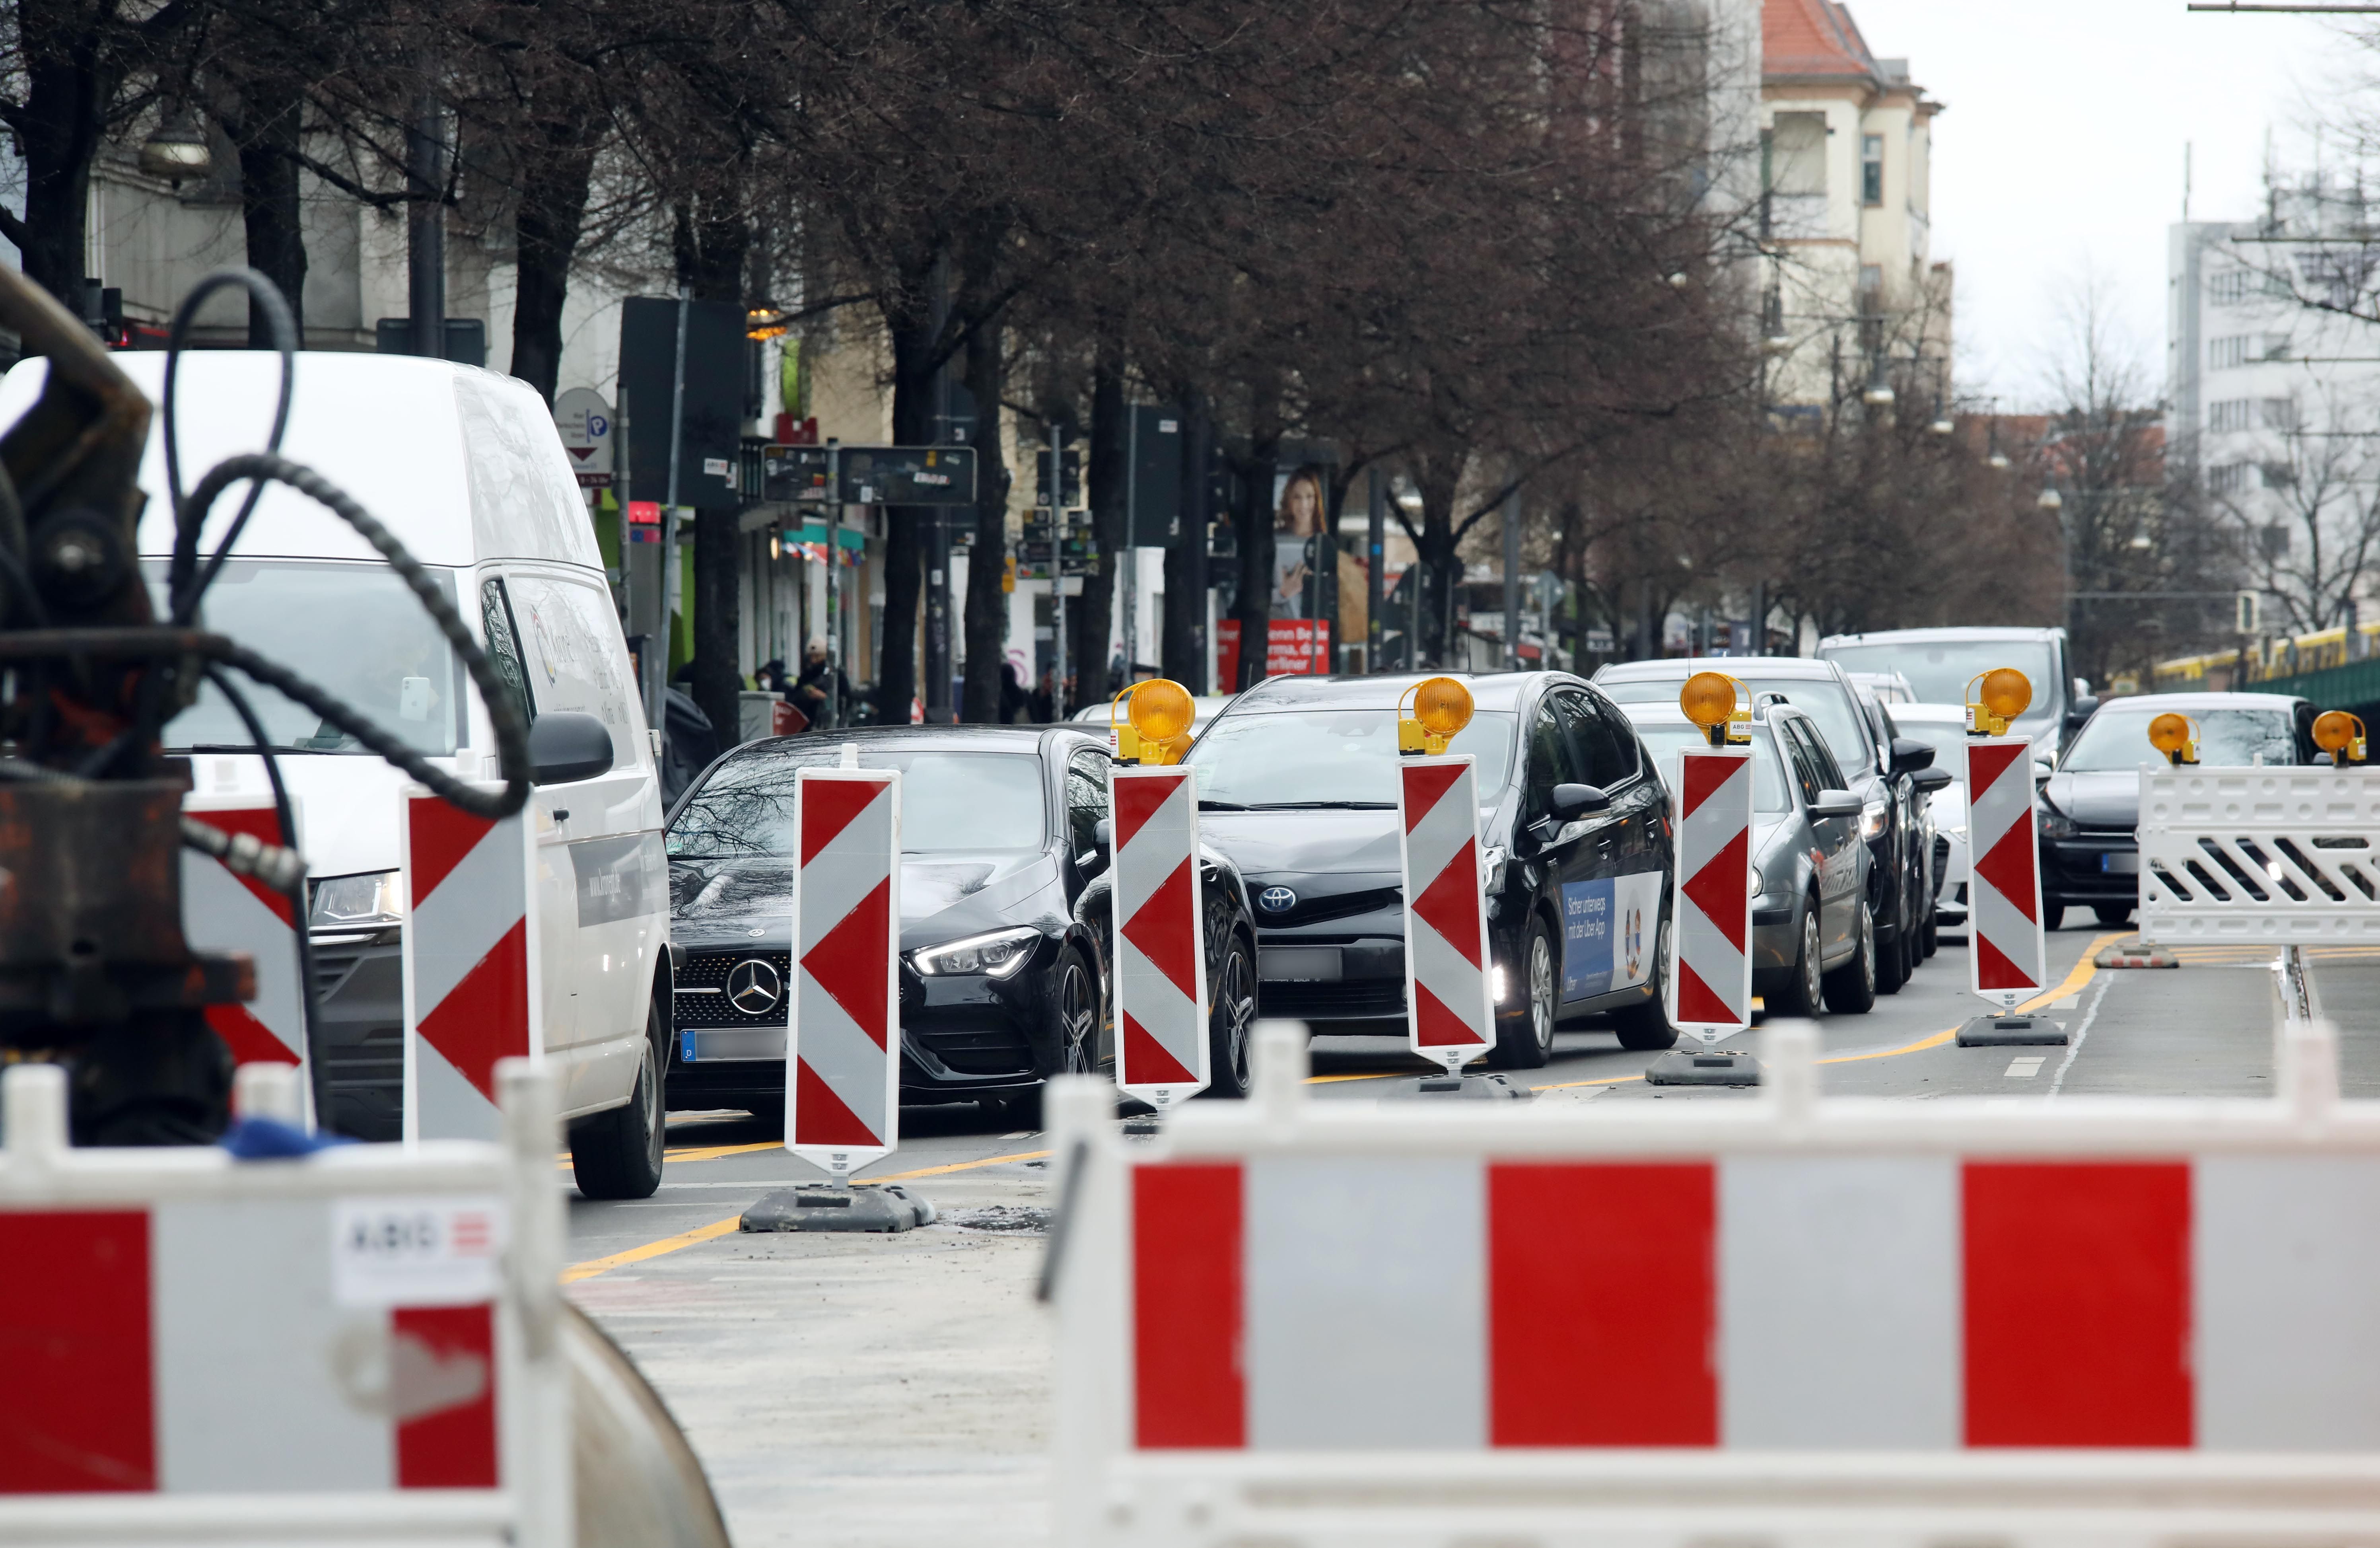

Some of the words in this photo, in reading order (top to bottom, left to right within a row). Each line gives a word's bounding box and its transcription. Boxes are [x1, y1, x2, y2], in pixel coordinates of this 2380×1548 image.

[1568, 898, 1583, 915] Sicher
[1583, 897, 1606, 915] unterwegs
[1576, 921, 1584, 938] der
[1584, 919, 1594, 937] Uber
[1595, 918, 1605, 939] App
[1567, 976, 1577, 992] Uber
